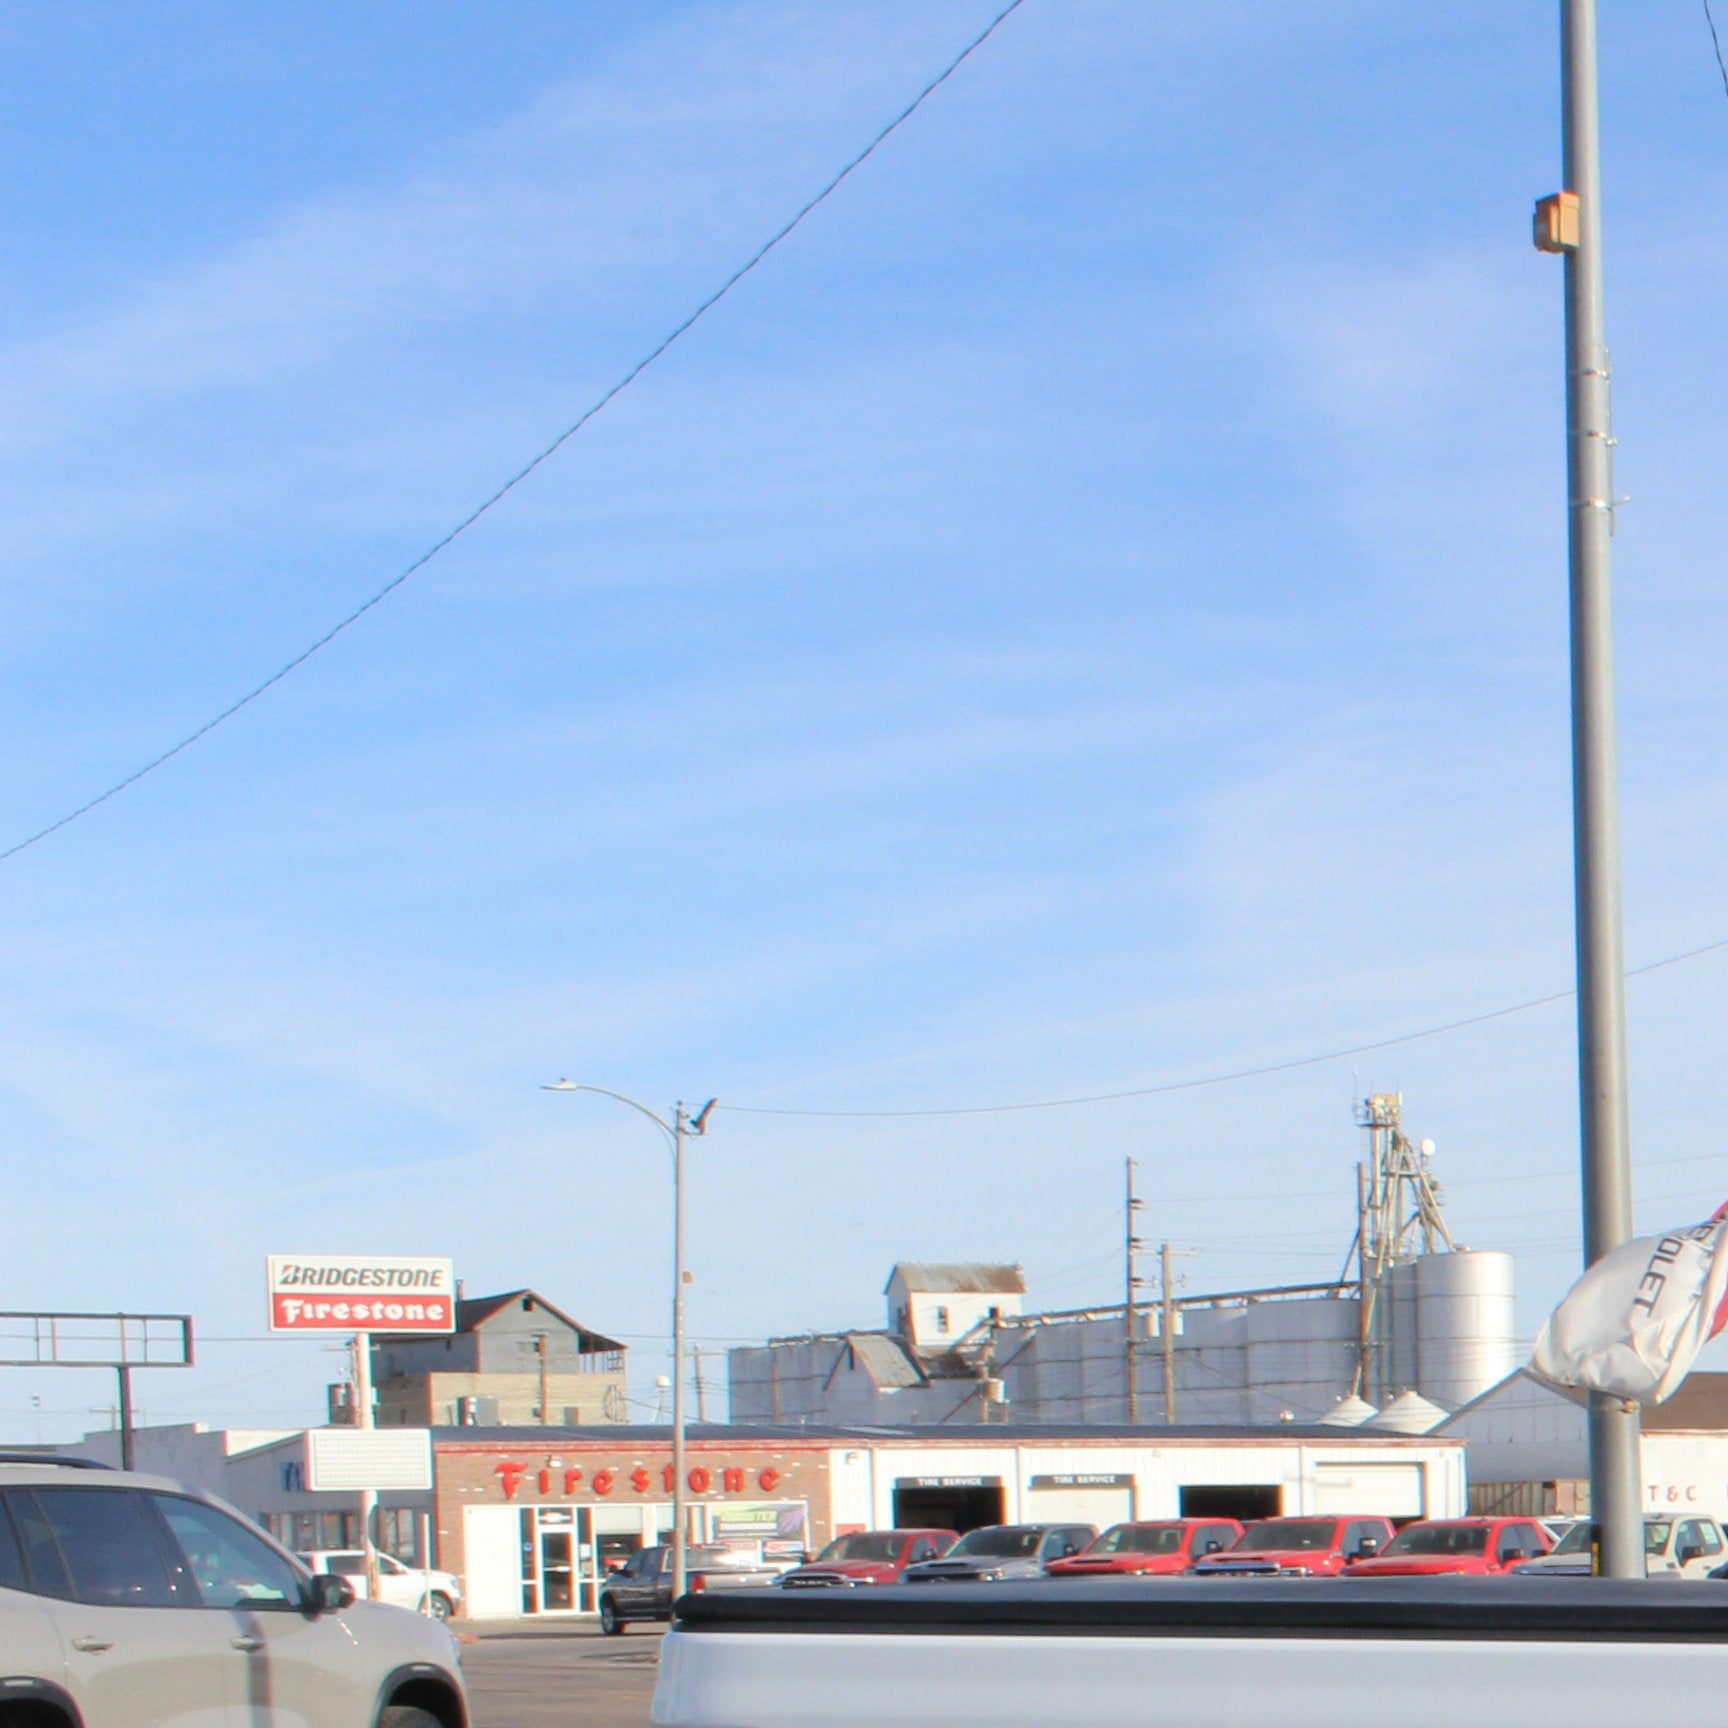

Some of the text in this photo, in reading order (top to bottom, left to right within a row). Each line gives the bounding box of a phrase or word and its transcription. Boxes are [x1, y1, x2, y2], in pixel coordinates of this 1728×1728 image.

[280, 1264, 443, 1288] BRIDGESTONE
[281, 1299, 444, 1324] Firestone
[495, 1462, 780, 1500] Firestone
[918, 1476, 983, 1486] TIRE SERVICE
[1053, 1475, 1116, 1484] TIRE SERVICE
